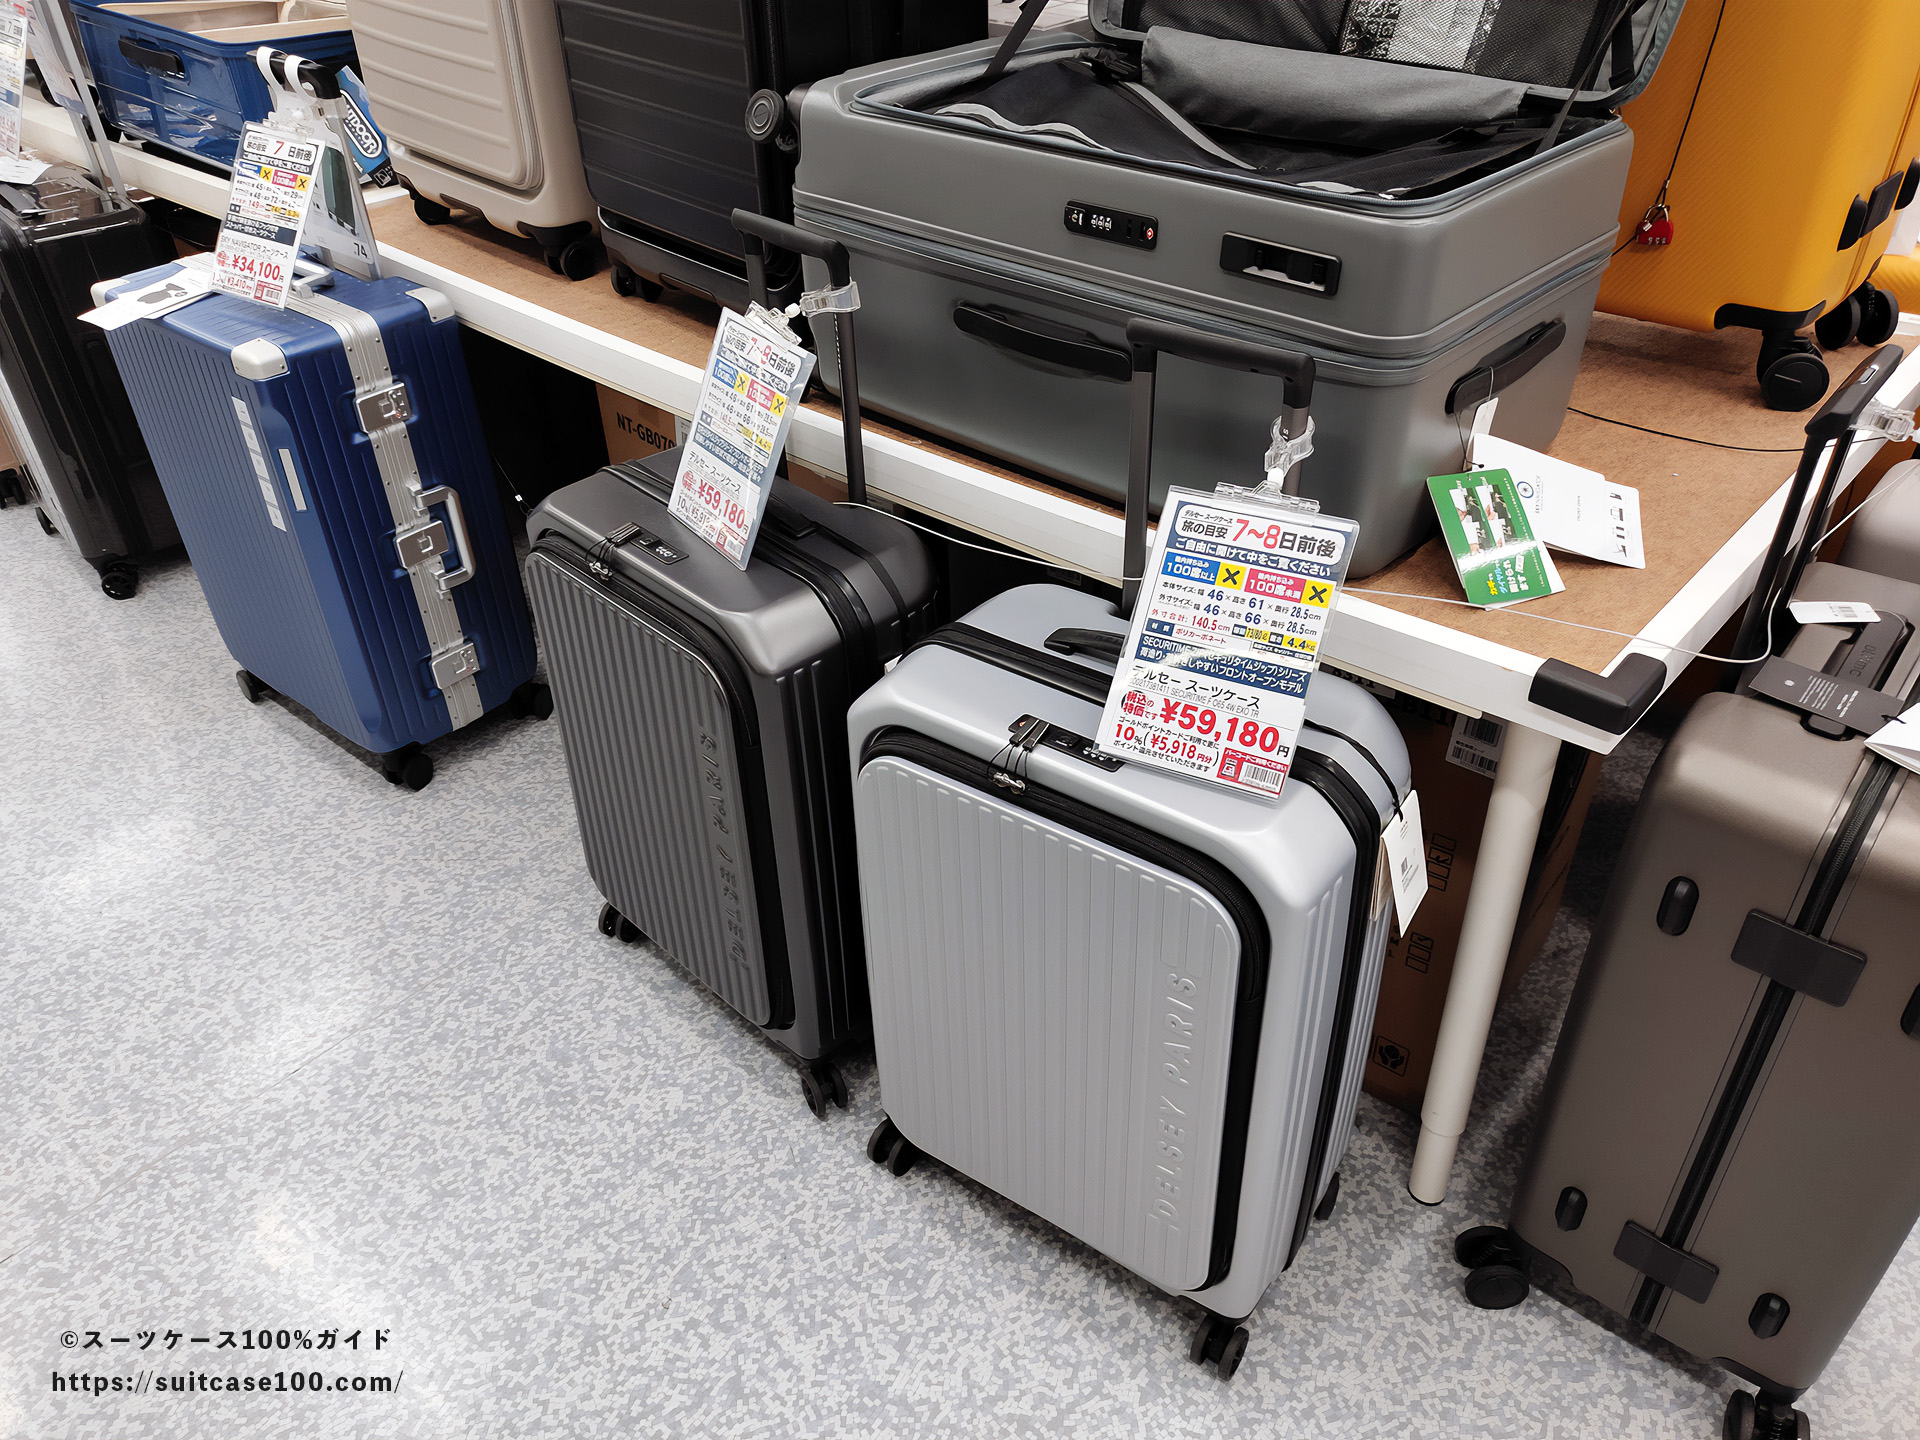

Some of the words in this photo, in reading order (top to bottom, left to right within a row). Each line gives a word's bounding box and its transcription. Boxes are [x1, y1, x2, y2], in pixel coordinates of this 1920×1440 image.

[345, 103, 377, 155] TDOOR
[1180, 519, 1228, 539] 旅の目安
[1174, 537, 1332, 578] ご自由に開けて中をご覧ください
[1202, 602, 1220, 615] 46
[1243, 611, 1262, 624] 66
[1206, 588, 1224, 601] 46
[1247, 597, 1265, 610] 61
[1175, 627, 1226, 645] ポリカーボネート
[1130, 664, 1182, 688] デルセー
[1185, 679, 1261, 709] スーツケース
[1170, 688, 1207, 704] SECURITIME
[1162, 972, 1197, 1085] PARIS
[1150, 1095, 1188, 1231] DELSEY
